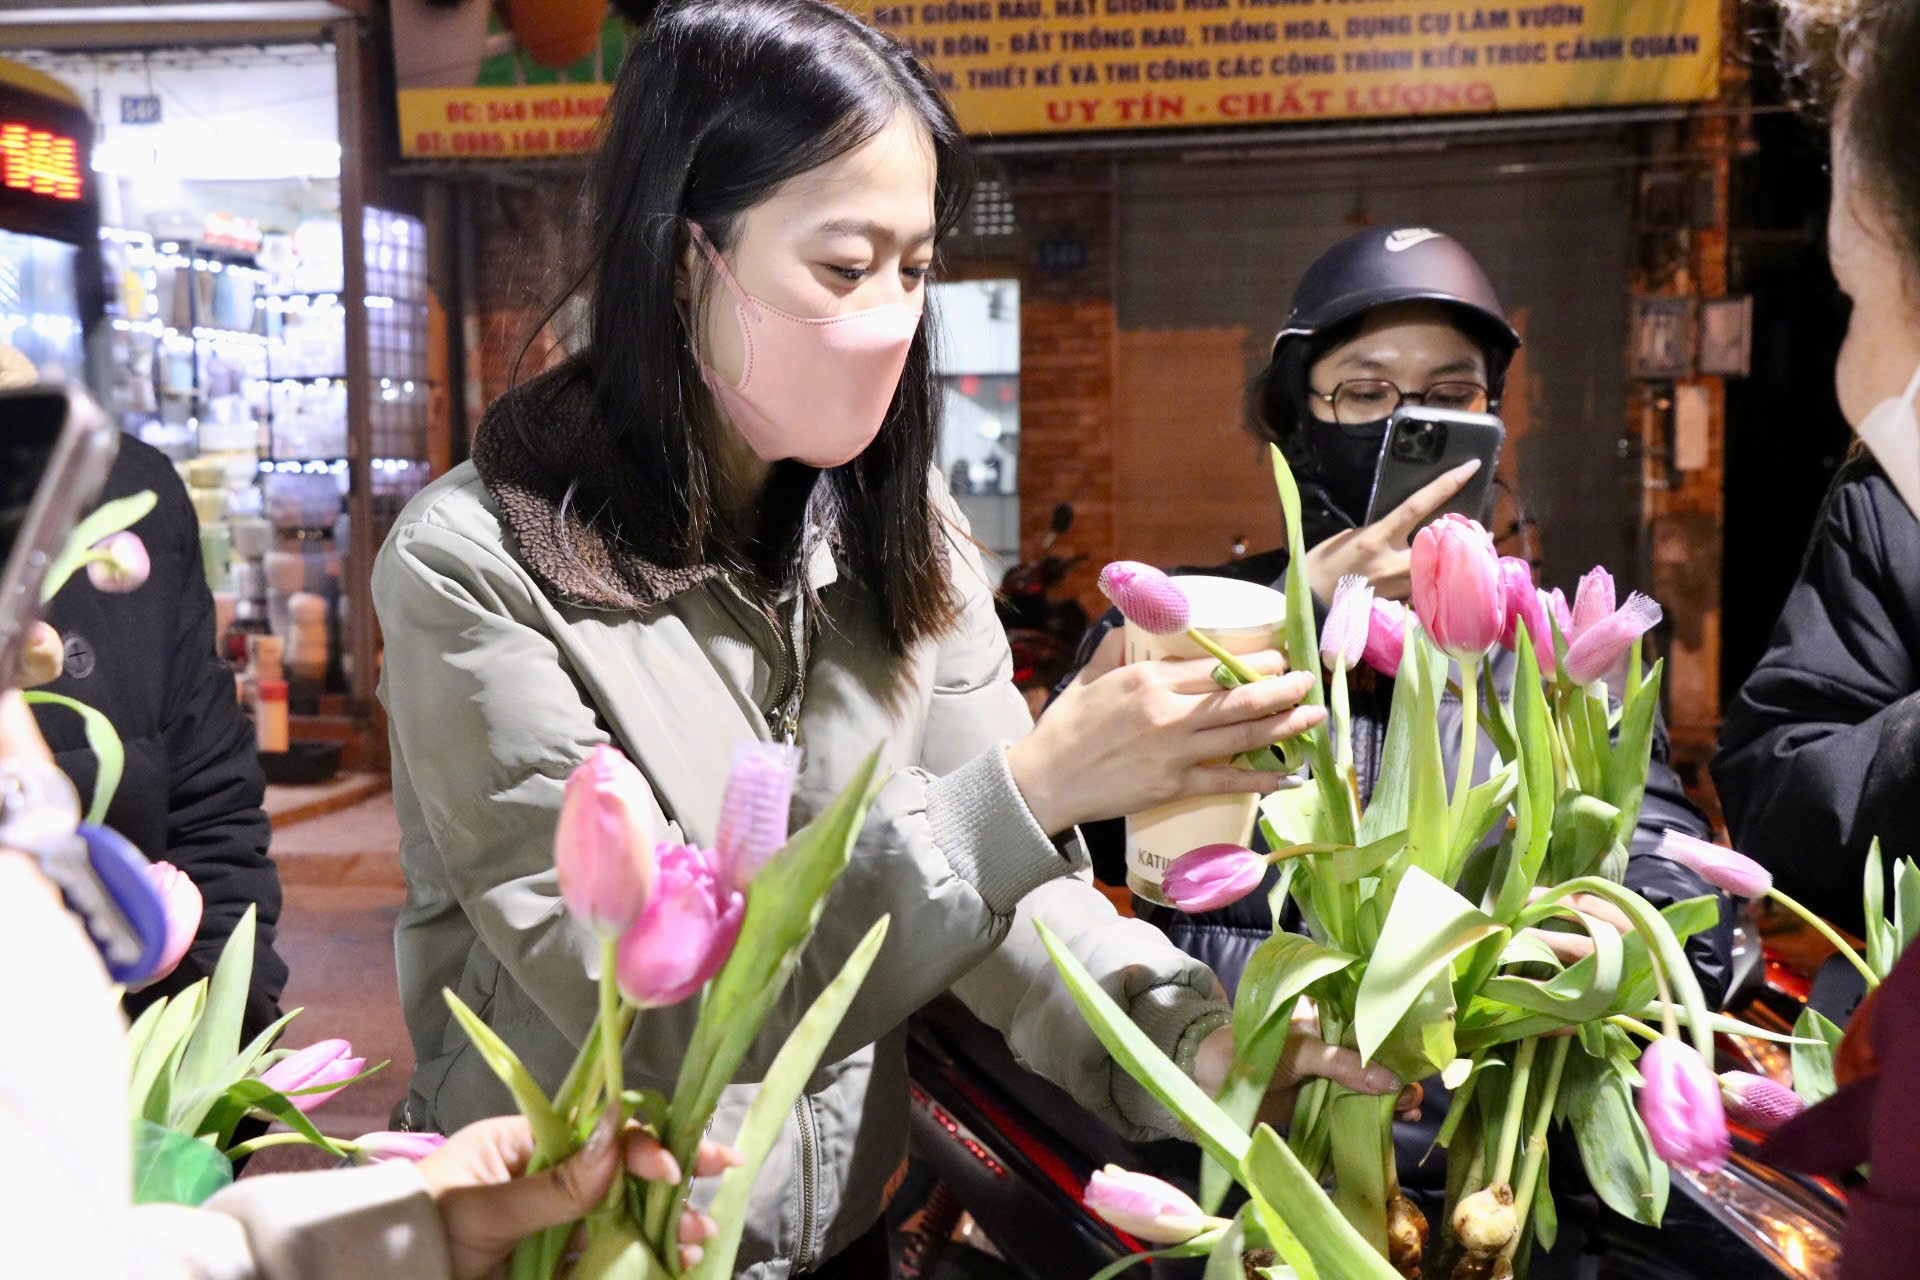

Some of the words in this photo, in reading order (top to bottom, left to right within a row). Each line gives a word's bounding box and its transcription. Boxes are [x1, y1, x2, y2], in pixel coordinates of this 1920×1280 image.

[1105, 61, 1140, 84] THI
[1147, 57, 1210, 81] CÔNG
[1216, 54, 1263, 79] CÁC
[1270, 52, 1335, 76] CÔNG
[1045, 98, 1102, 125] UY
[1114, 90, 1185, 121] TÍN
[1217, 78, 1334, 118] CHẤT
